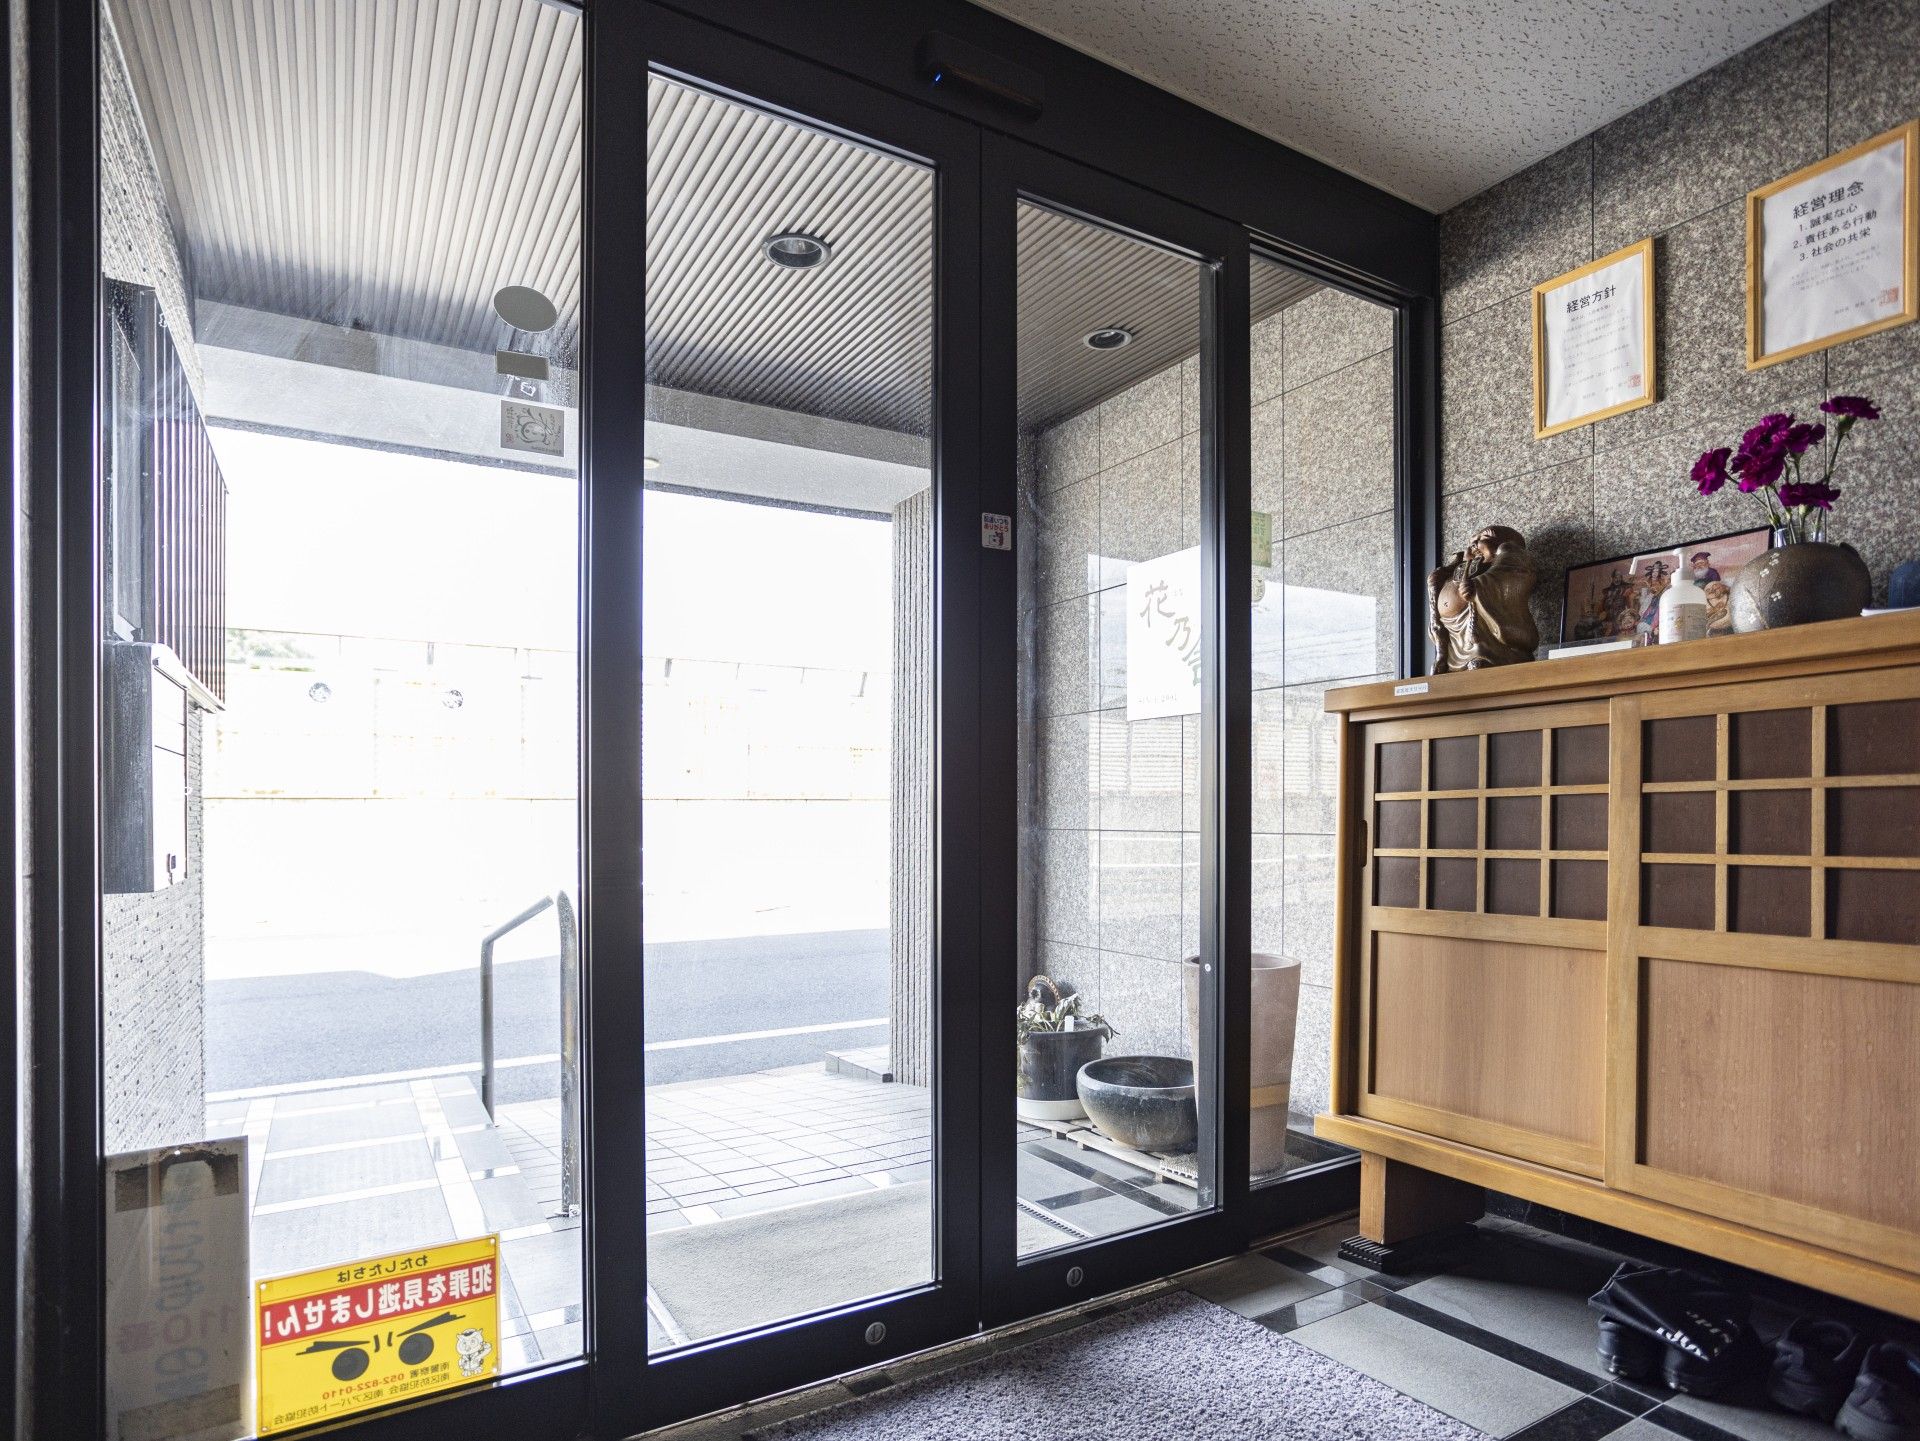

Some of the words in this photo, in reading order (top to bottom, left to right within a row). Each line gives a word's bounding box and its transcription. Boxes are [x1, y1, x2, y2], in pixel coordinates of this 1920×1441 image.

[1793, 181, 1864, 219] 経営理念
[1566, 284, 1616, 313] 経営方針
